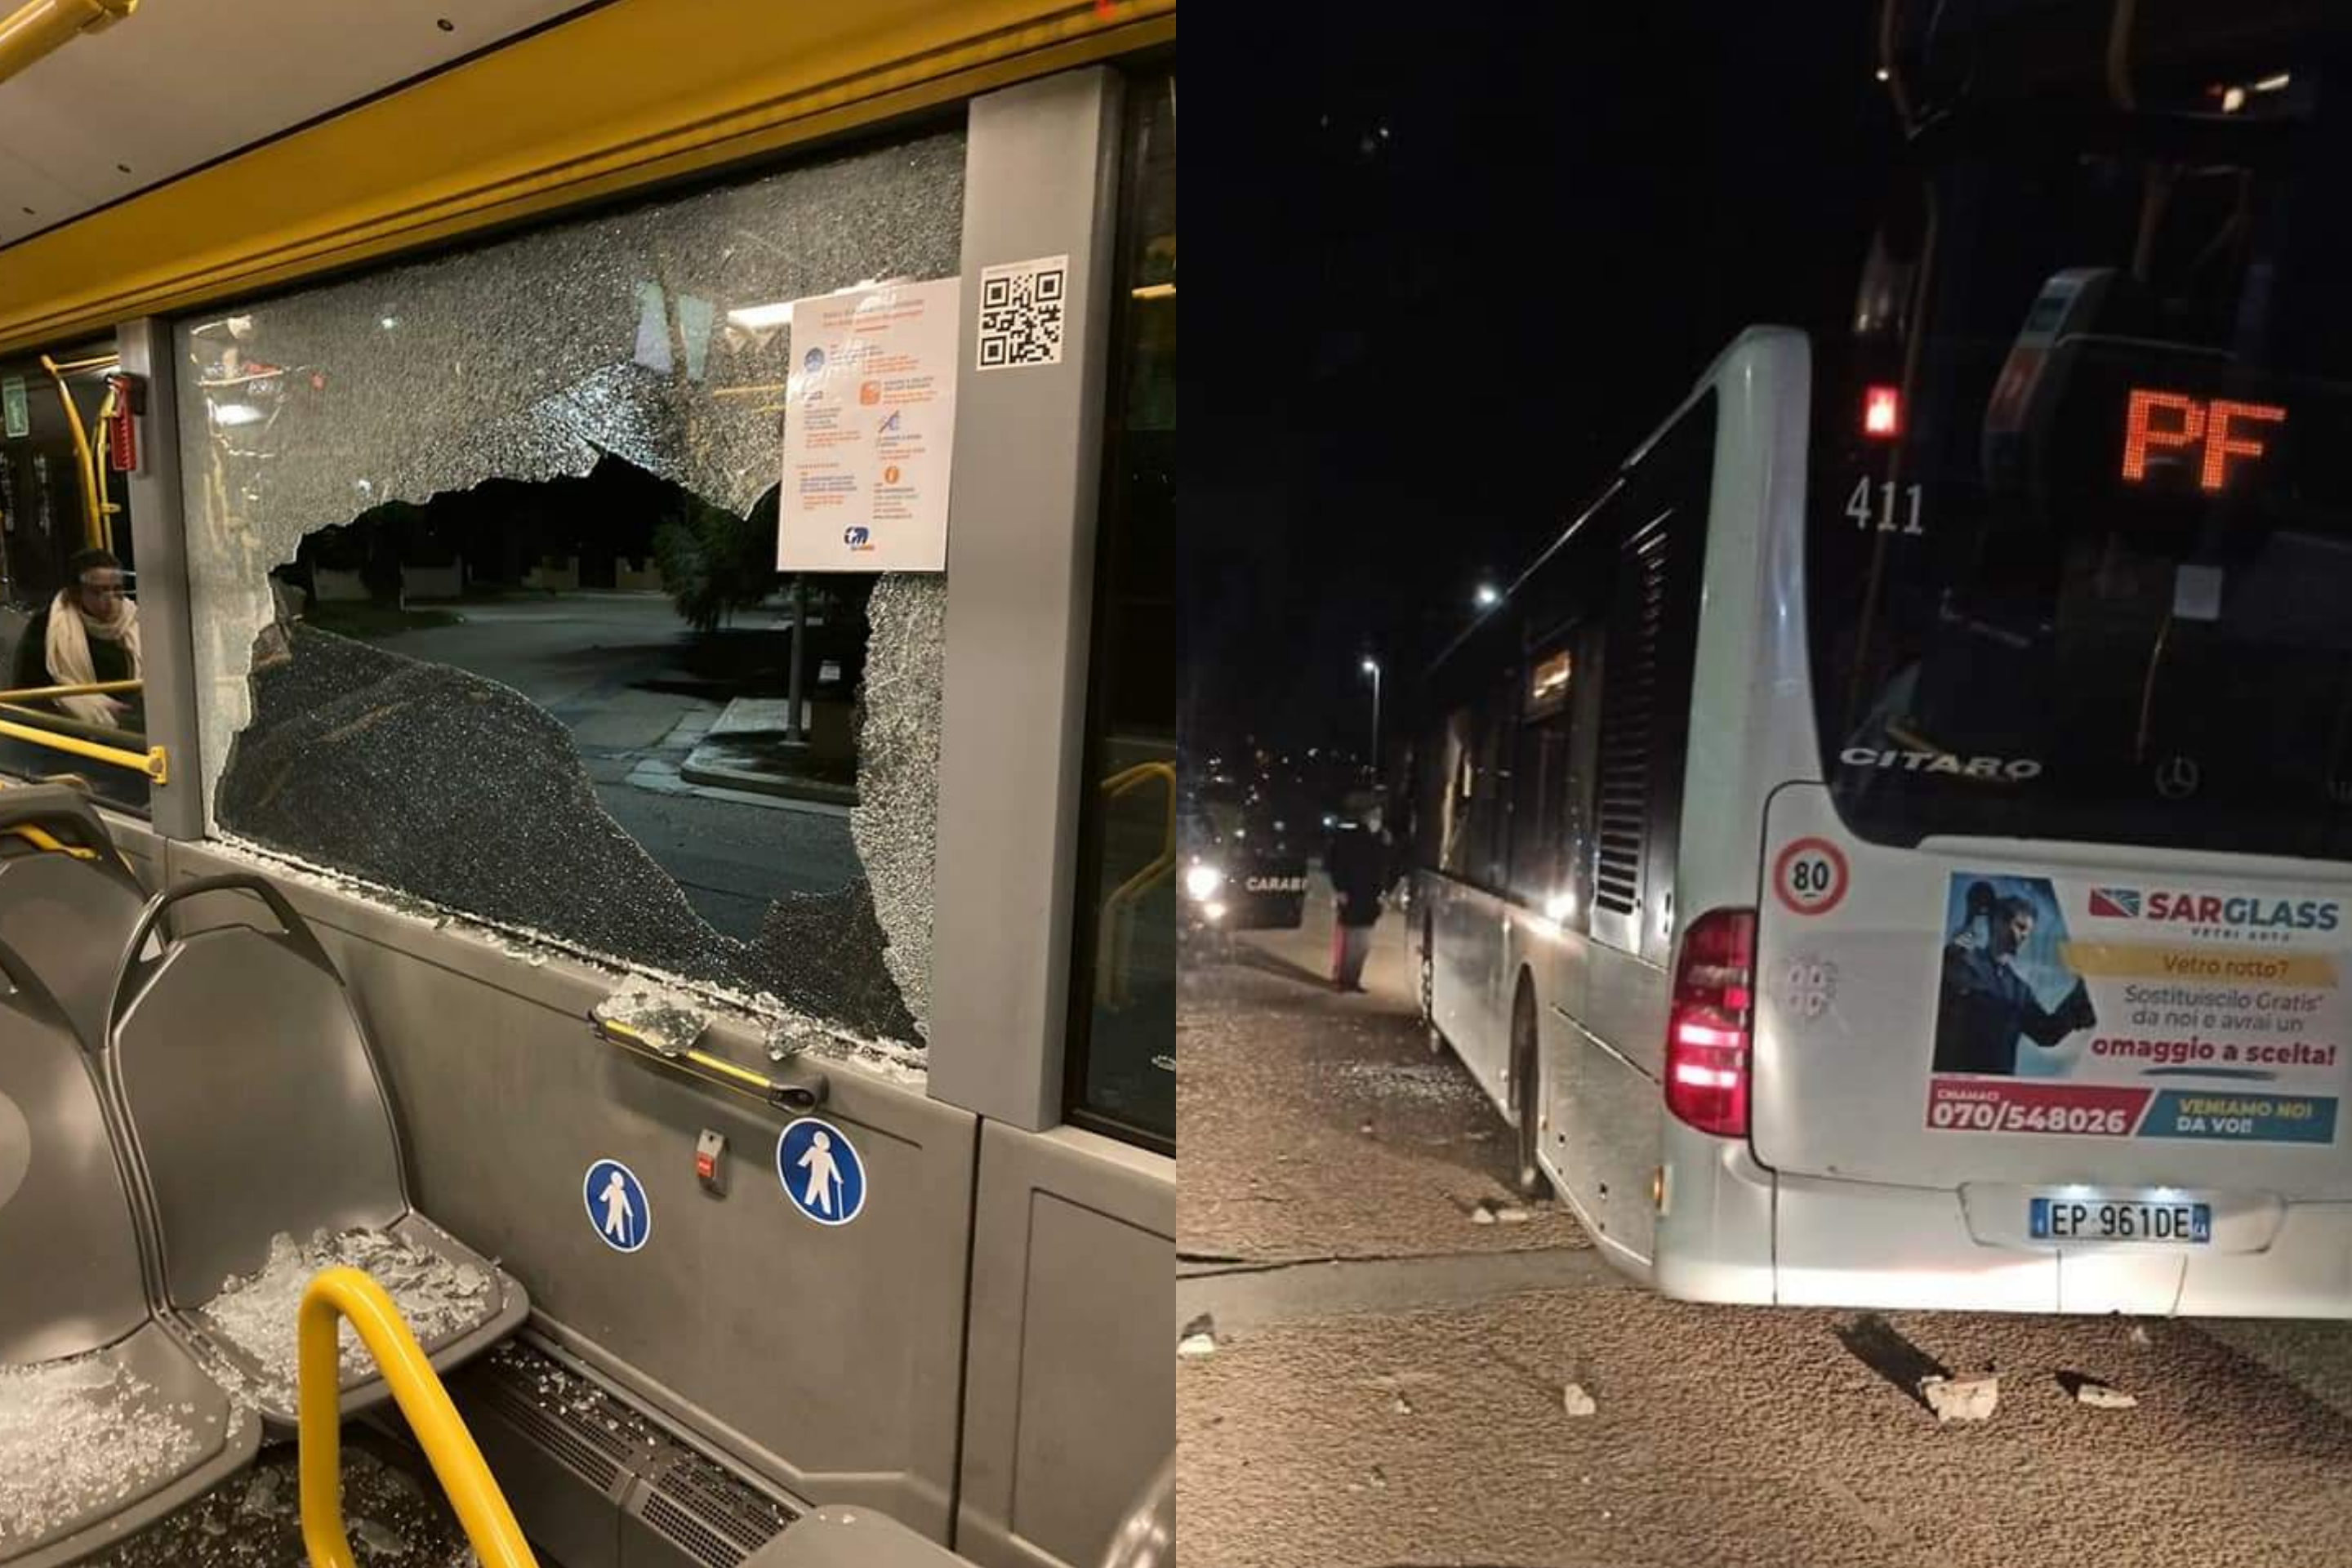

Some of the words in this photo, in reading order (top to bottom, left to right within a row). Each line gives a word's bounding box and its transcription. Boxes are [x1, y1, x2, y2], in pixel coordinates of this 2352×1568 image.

[2123, 389, 2286, 488] PF
[1846, 475, 1923, 535] 411
[1839, 747, 2042, 781] CITARO
[1793, 860, 1829, 892] 80
[2146, 891, 2340, 930] SARGLASS
[2164, 954, 2221, 973] Vetro
[2226, 957, 2289, 978] rotto?
[2124, 984, 2251, 1009] Sostituiscilo
[2132, 1009, 2158, 1026] da
[2164, 1009, 2199, 1027] noi
[2203, 1013, 2216, 1027] e
[2221, 1013, 2271, 1031] avrai
[2276, 1016, 2304, 1032] un
[2091, 1036, 2215, 1063] omaggio
[2222, 1044, 2238, 1061] a
[2246, 1041, 2336, 1066] scelta!
[1932, 1101, 2127, 1133] 070/548026
[2176, 1117, 2206, 1133] DA
[2051, 1204, 2087, 1236] EP
[2100, 1205, 2189, 1238] 961DE
